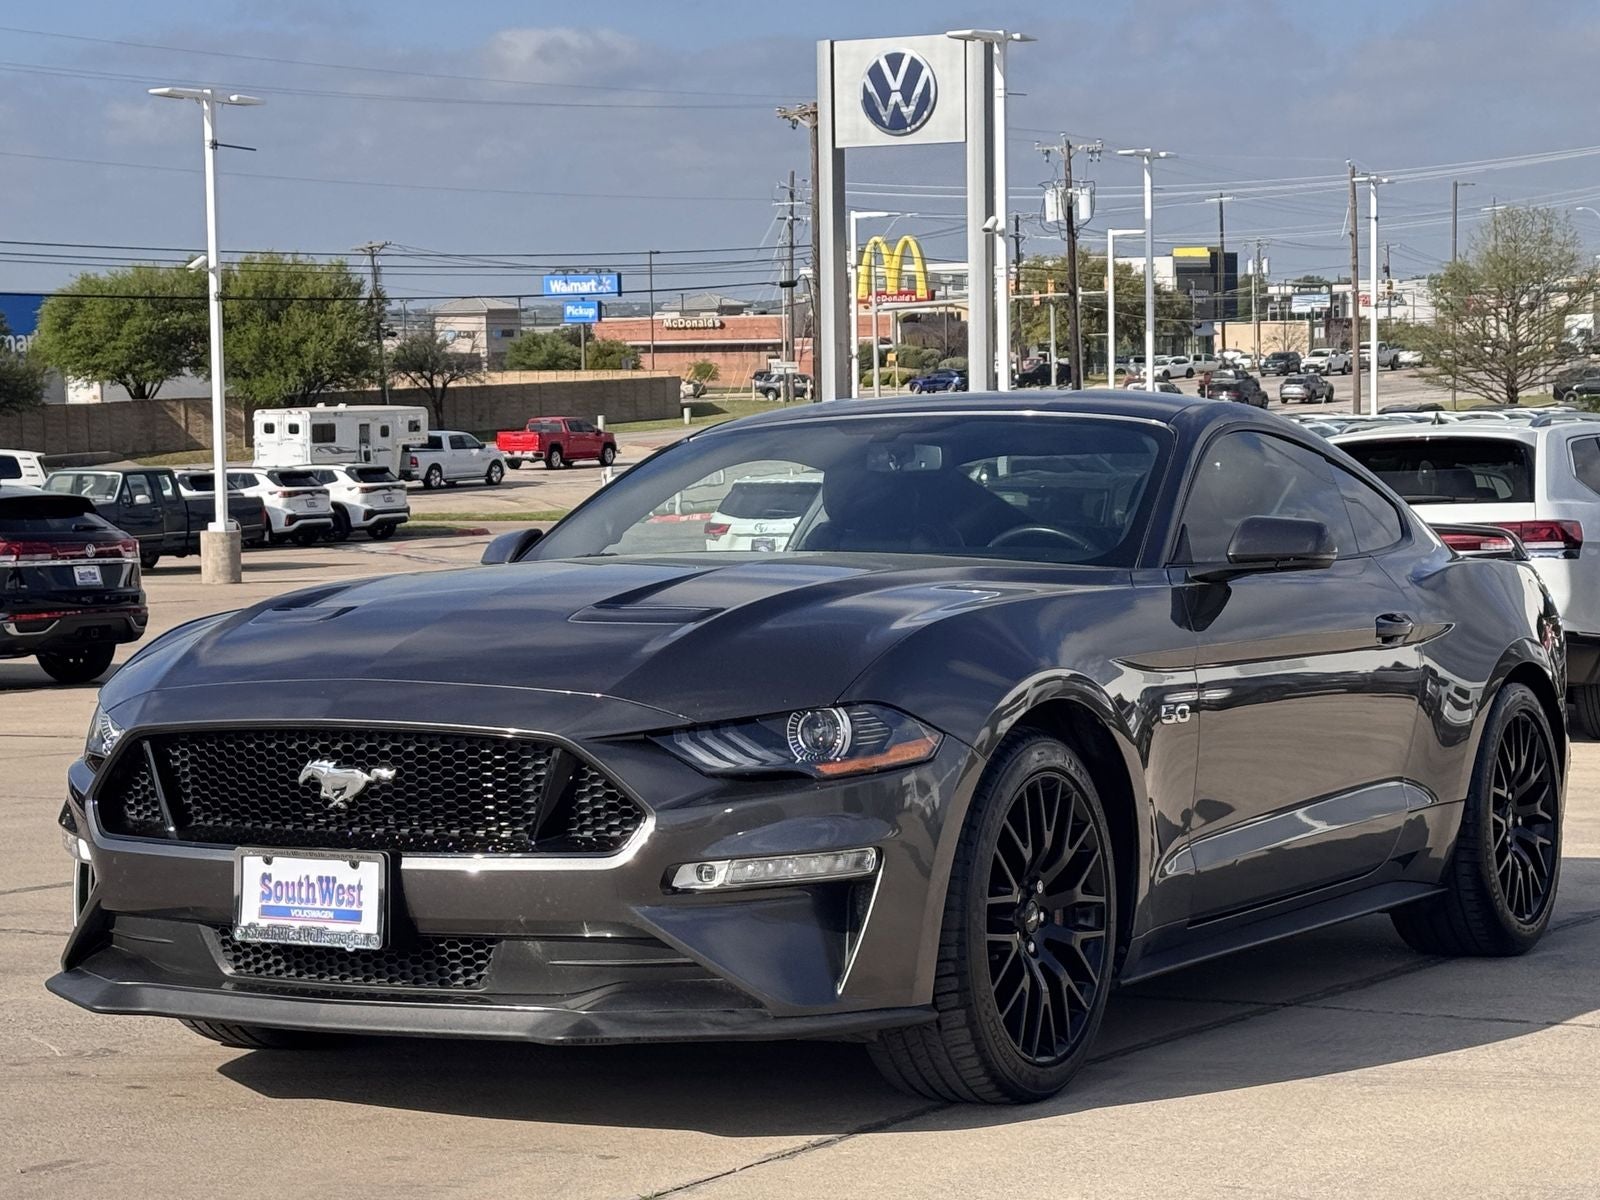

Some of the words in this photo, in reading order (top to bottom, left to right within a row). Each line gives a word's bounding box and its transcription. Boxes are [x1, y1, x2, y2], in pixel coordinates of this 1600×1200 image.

[549, 279, 597, 293] Walmart
[566, 305, 595, 318] Pickup
[663, 318, 721, 328] McDonald's
[259, 871, 363, 908] SouthWest
[290, 909, 335, 919] VOLKSWAGEN
